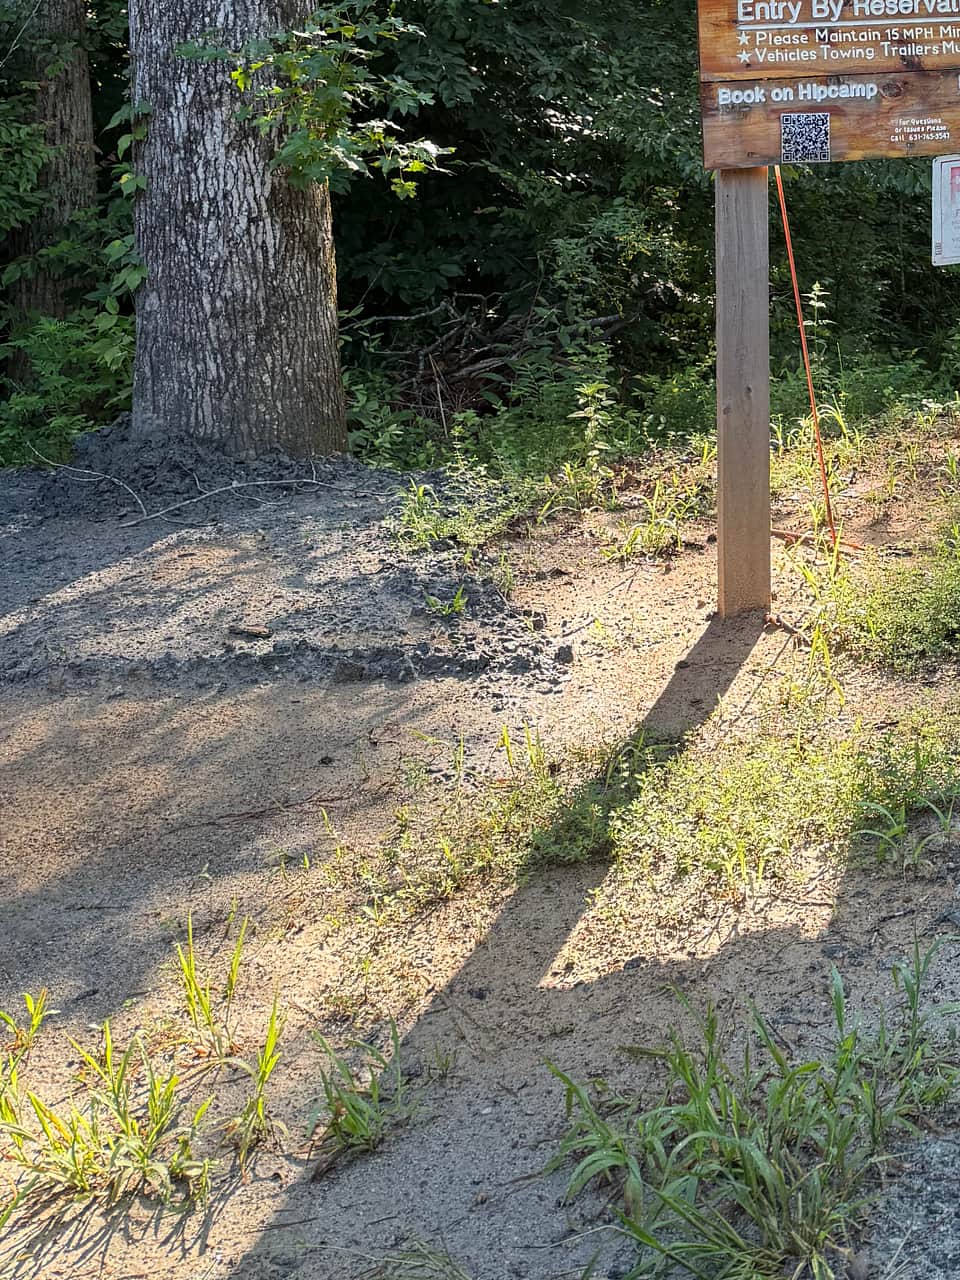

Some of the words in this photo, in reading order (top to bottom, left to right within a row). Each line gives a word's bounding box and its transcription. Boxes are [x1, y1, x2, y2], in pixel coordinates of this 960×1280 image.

[755, 31, 809, 46] Please
[815, 28, 881, 43] Maintain
[885, 29, 900, 41] 15
[903, 27, 934, 40] MPH
[754, 47, 817, 63] Vehicles
[820, 44, 875, 60] Towing
[880, 41, 940, 57] Trailers
[718, 86, 766, 105] Book
[770, 87, 794, 101] on
[798, 83, 878, 102] Hipcamp
